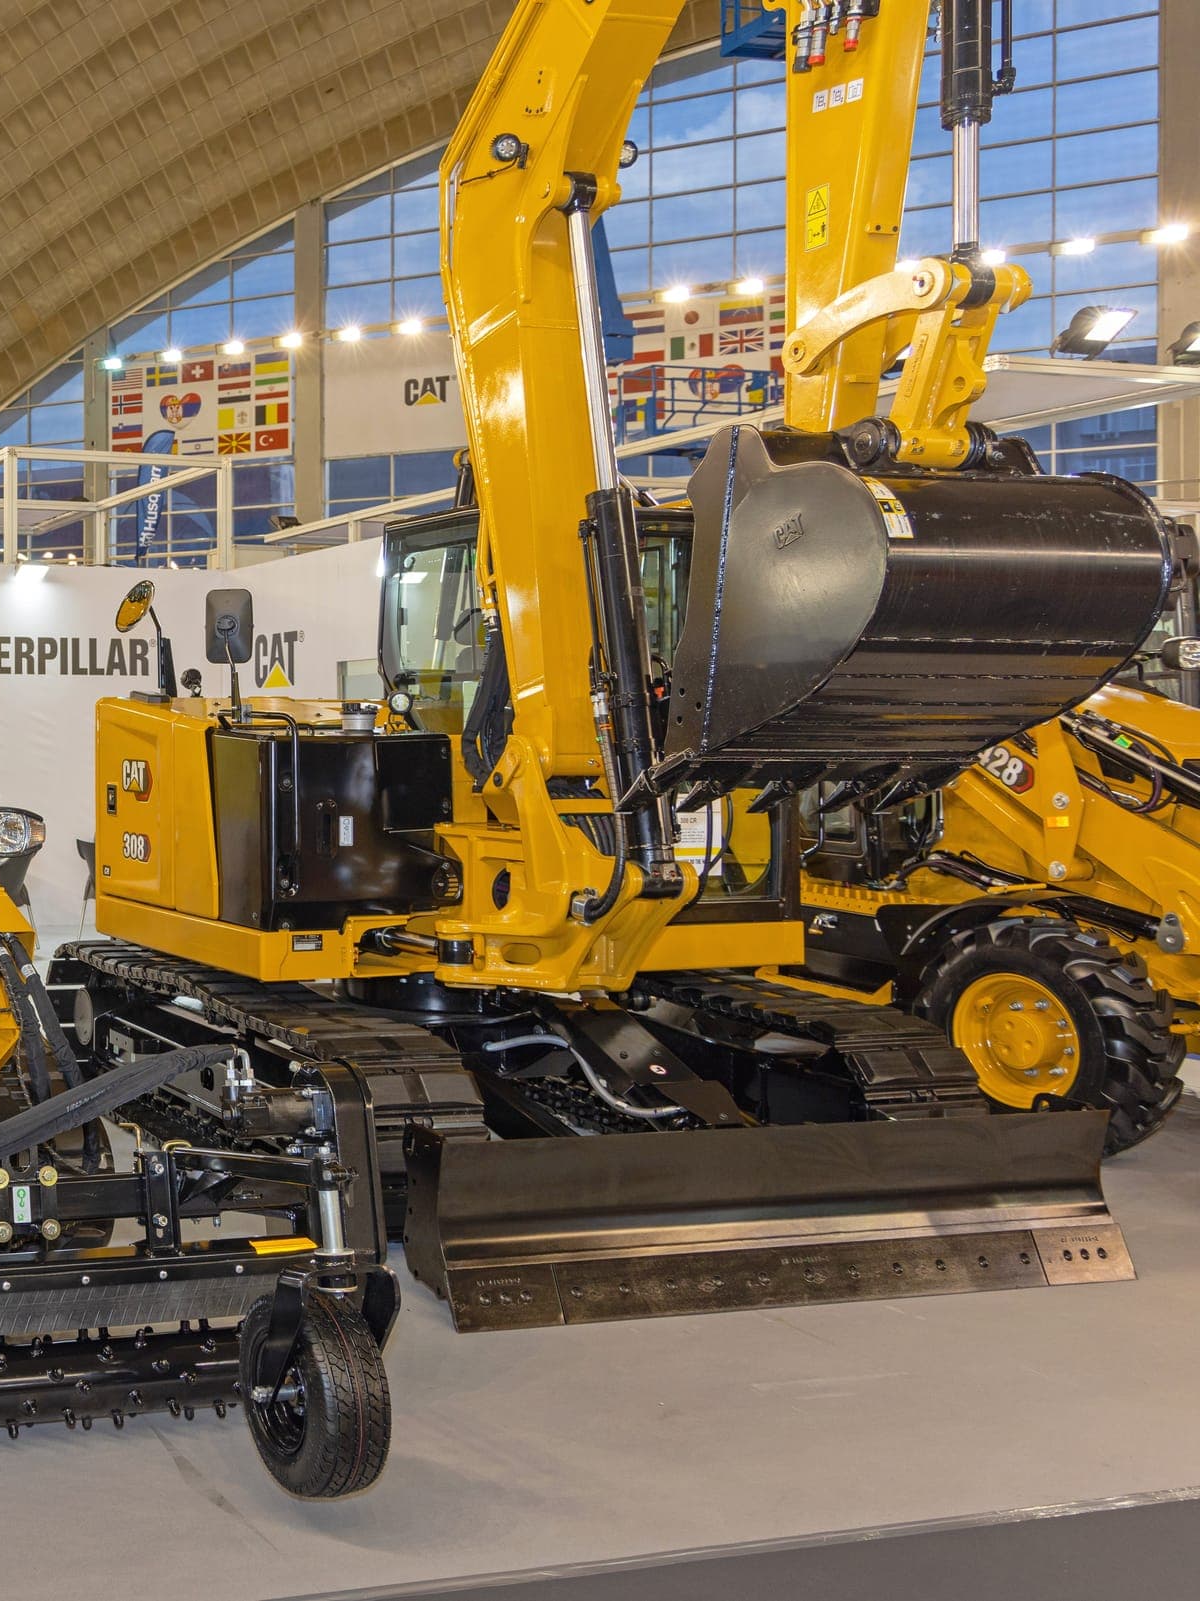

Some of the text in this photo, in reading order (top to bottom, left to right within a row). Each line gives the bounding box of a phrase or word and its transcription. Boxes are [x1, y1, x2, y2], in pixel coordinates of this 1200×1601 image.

[404, 375, 451, 407] CAT
[772, 512, 805, 551] CAT
[254, 631, 298, 689] CAT
[122, 760, 146, 792] CAT
[123, 832, 145, 860] 308
